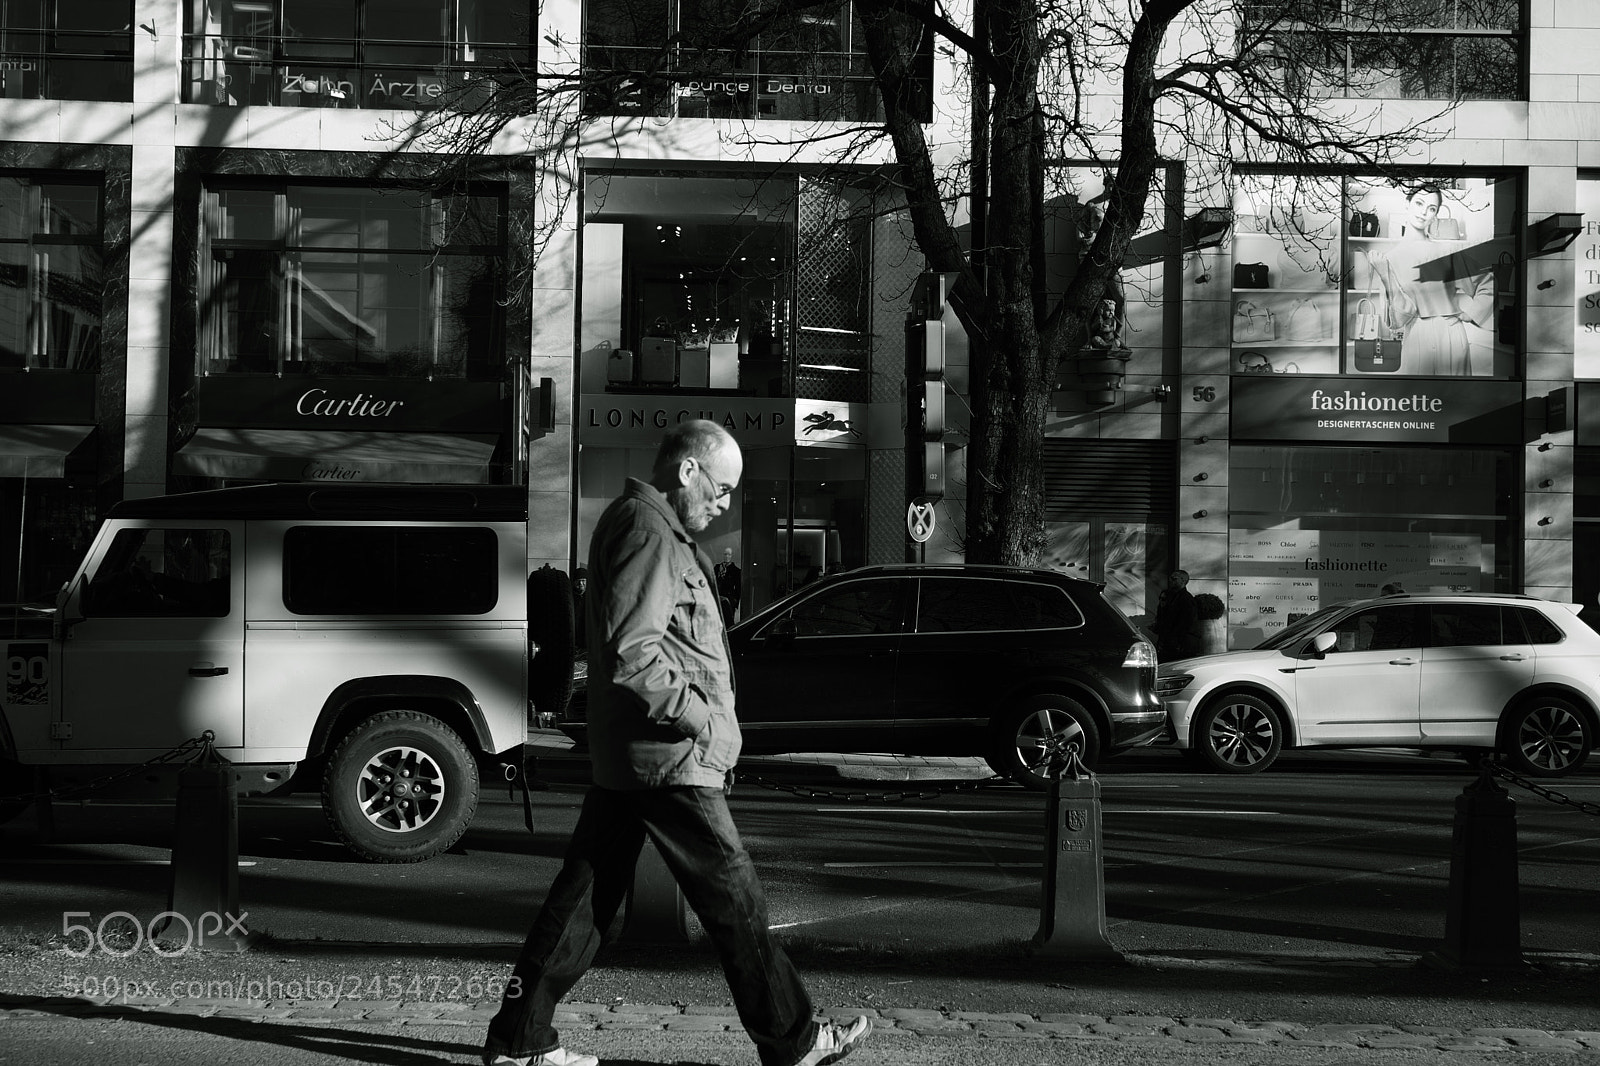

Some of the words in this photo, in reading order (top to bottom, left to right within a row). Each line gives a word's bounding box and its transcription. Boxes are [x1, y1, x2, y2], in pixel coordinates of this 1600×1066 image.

[282, 74, 354, 94] Zahn
[369, 74, 443, 98] Ärzte
[296, 388, 404, 417] Cartier
[1193, 386, 1216, 403] 56
[1310, 389, 1443, 412] fashionette
[1317, 419, 1401, 430] DESIGNERTASCHEN
[1402, 421, 1436, 430] ONLINE
[301, 460, 361, 480] Cartier
[1304, 557, 1388, 572] fashionette
[8, 655, 48, 685] 90
